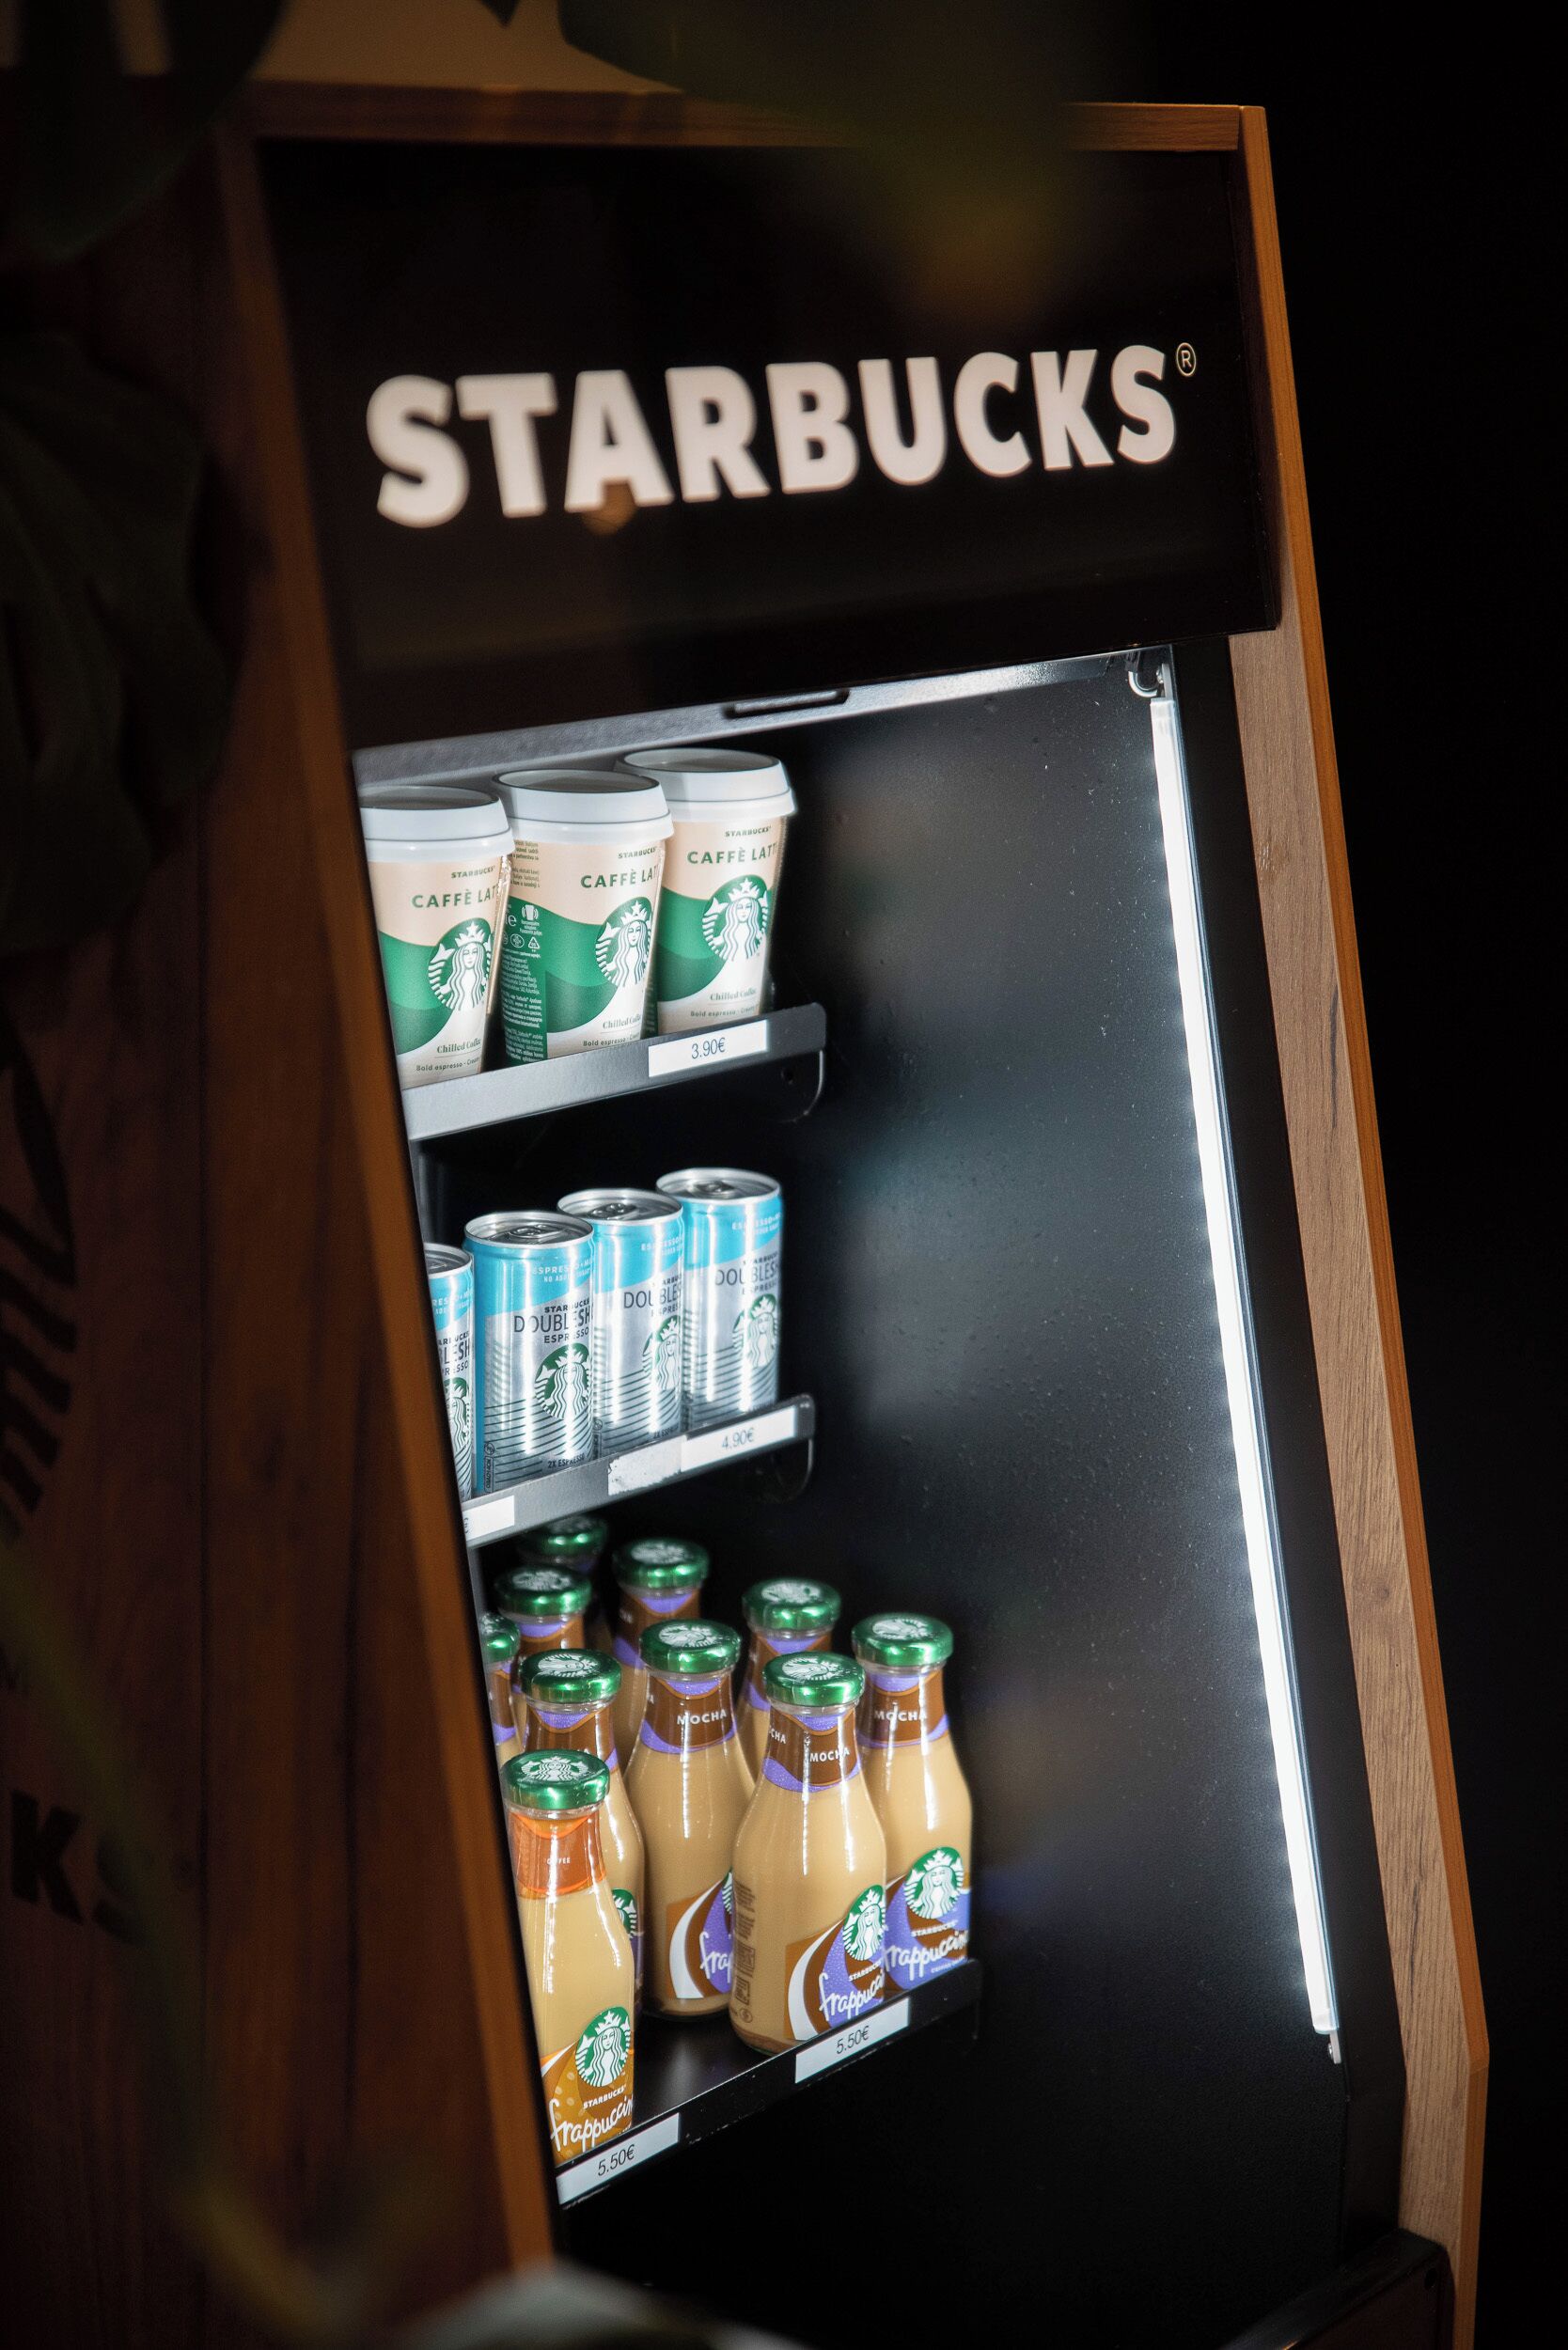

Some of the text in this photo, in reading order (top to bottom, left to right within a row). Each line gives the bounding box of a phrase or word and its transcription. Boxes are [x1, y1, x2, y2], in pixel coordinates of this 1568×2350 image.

[687, 847, 746, 864] CAFFÈ
[580, 869, 636, 888] CAFFÈ
[412, 888, 472, 909] CAFFÈ
[710, 991, 739, 1001] Chilled
[603, 1017, 629, 1029] Chilled
[436, 1042, 465, 1054] Chilled
[583, 1039, 599, 1047] Bold
[601, 1037, 626, 1047] espresso
[691, 1037, 726, 1059] 3.90€
[435, 1061, 463, 1072] espresso
[722, 1428, 755, 1449] 4.90€
[547, 1459, 557, 1470] 2X
[677, 1709, 727, 1726] MOCHA
[874, 1710, 927, 1722] MOCHA
[809, 1747, 851, 1762] MOCHA
[837, 2025, 870, 2054] 5.50€
[583, 2084, 626, 2109] STARBUCKS
[598, 2144, 635, 2177] 5.50€
